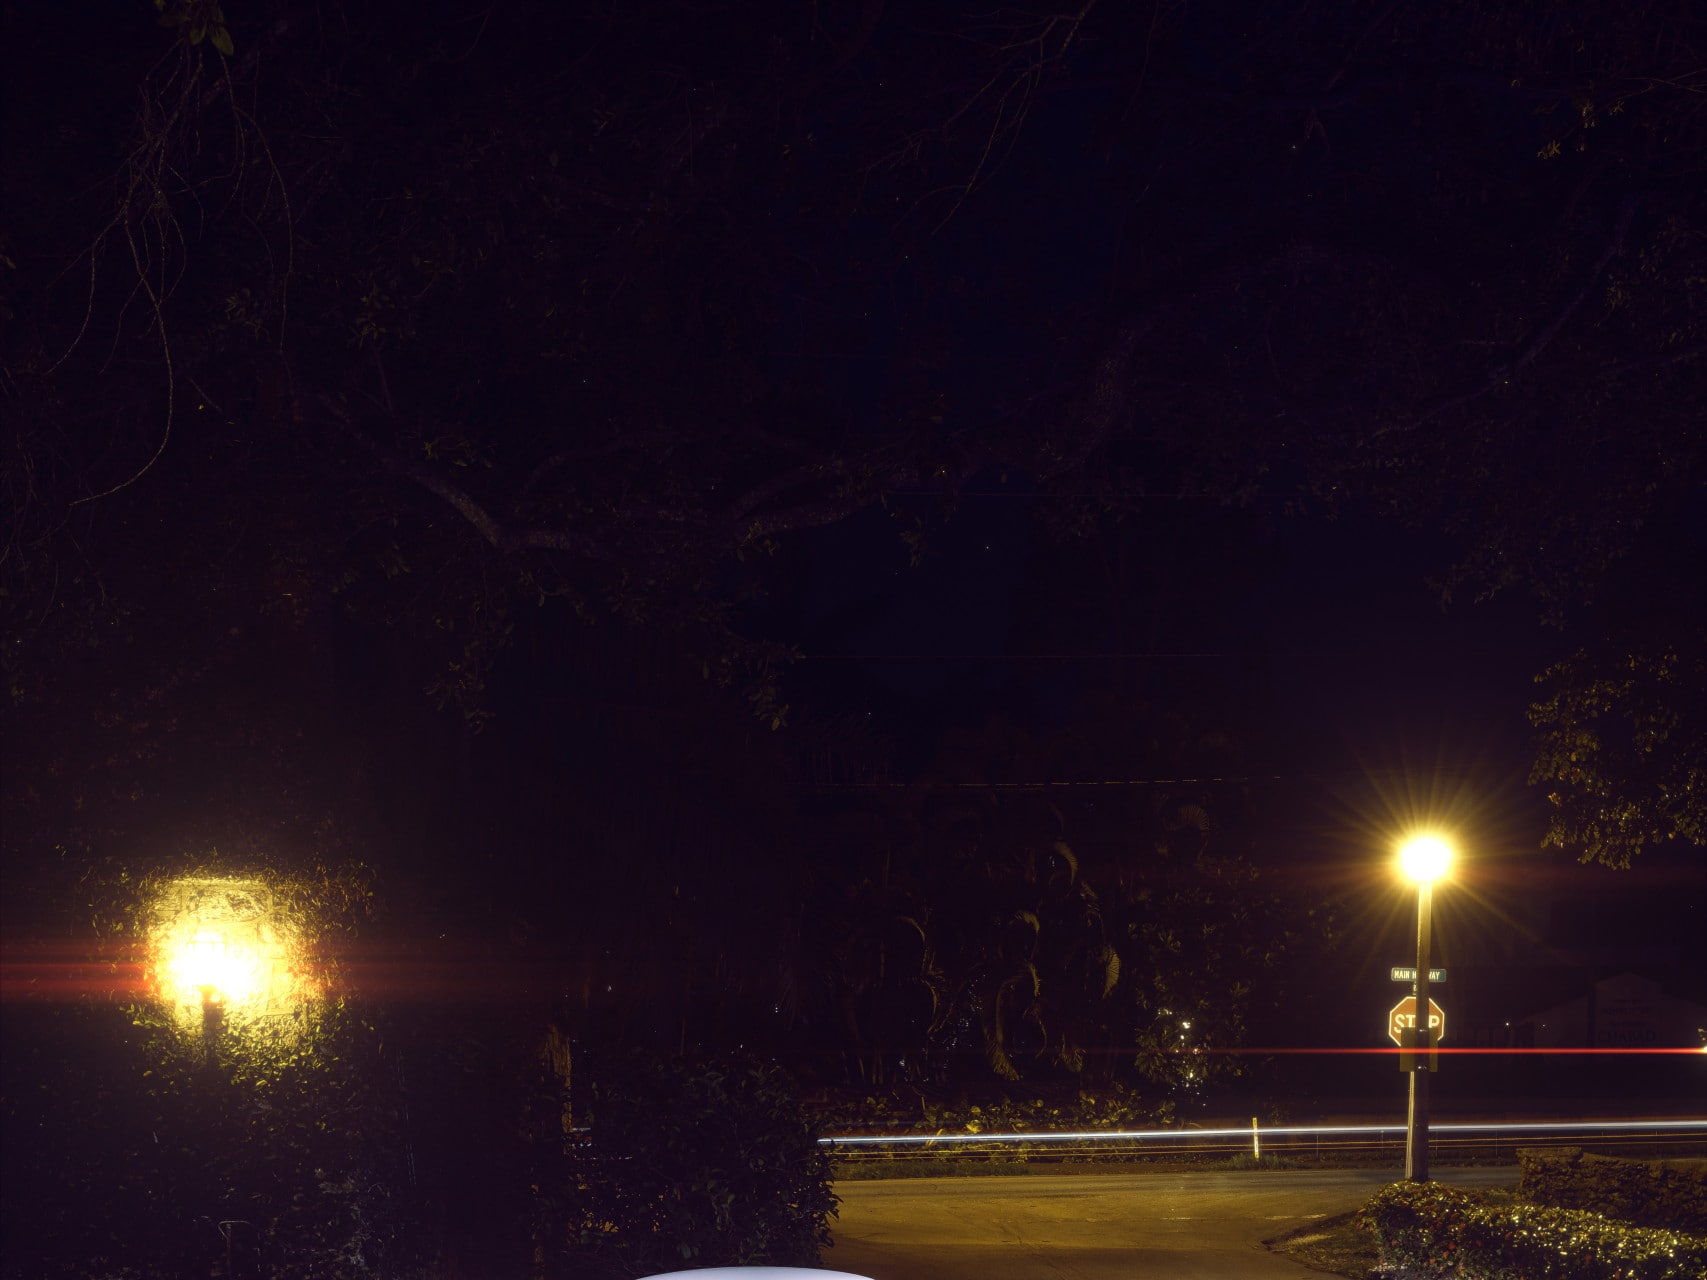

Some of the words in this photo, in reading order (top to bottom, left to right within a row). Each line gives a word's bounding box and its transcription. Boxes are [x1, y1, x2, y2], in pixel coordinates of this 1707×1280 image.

[1394, 970, 1410, 980] MAIN
[1411, 970, 1441, 981] HWAY
[1393, 1013, 1441, 1034] STP
